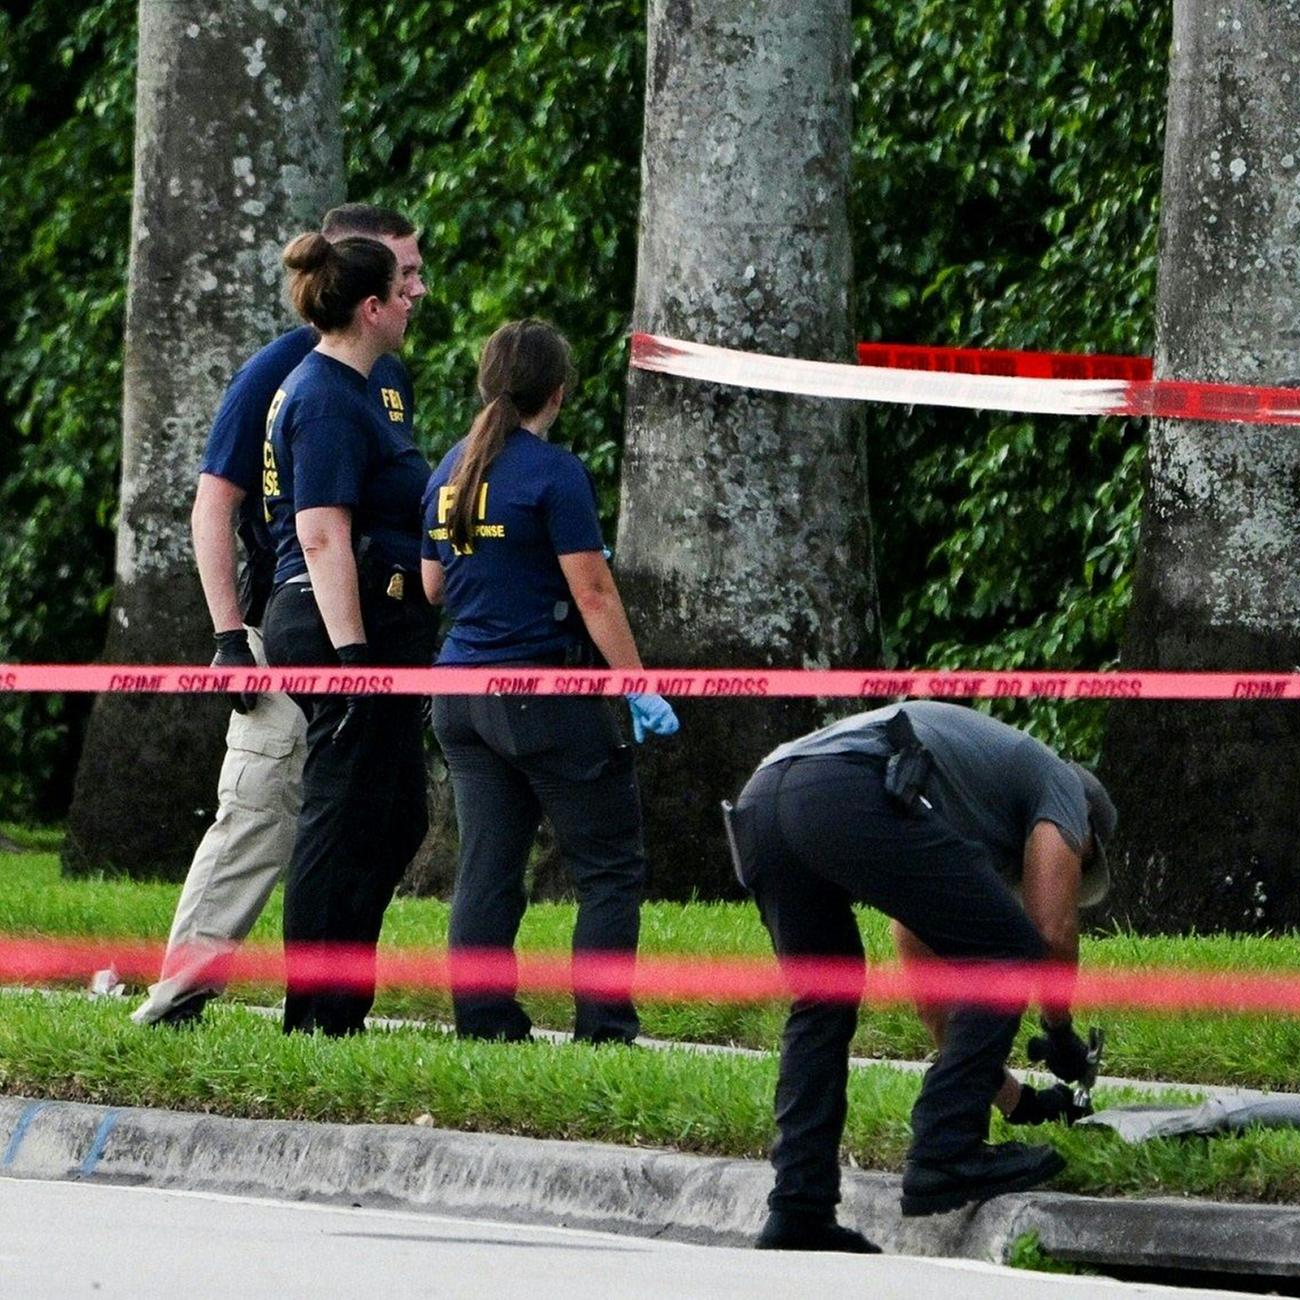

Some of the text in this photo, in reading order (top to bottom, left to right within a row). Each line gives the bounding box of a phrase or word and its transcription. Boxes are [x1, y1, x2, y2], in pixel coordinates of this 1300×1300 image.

[381, 388, 404, 410] FBI
[438, 482, 489, 524] FI
[109, 674, 394, 692] CRIME SCENE DO NOT CROSS
[485, 676, 769, 693] CRIME SCENE DO NOT CROSS
[860, 678, 1143, 695] CRIME SCENE DO NOT CROSS
[1233, 680, 1292, 697] CRIME
